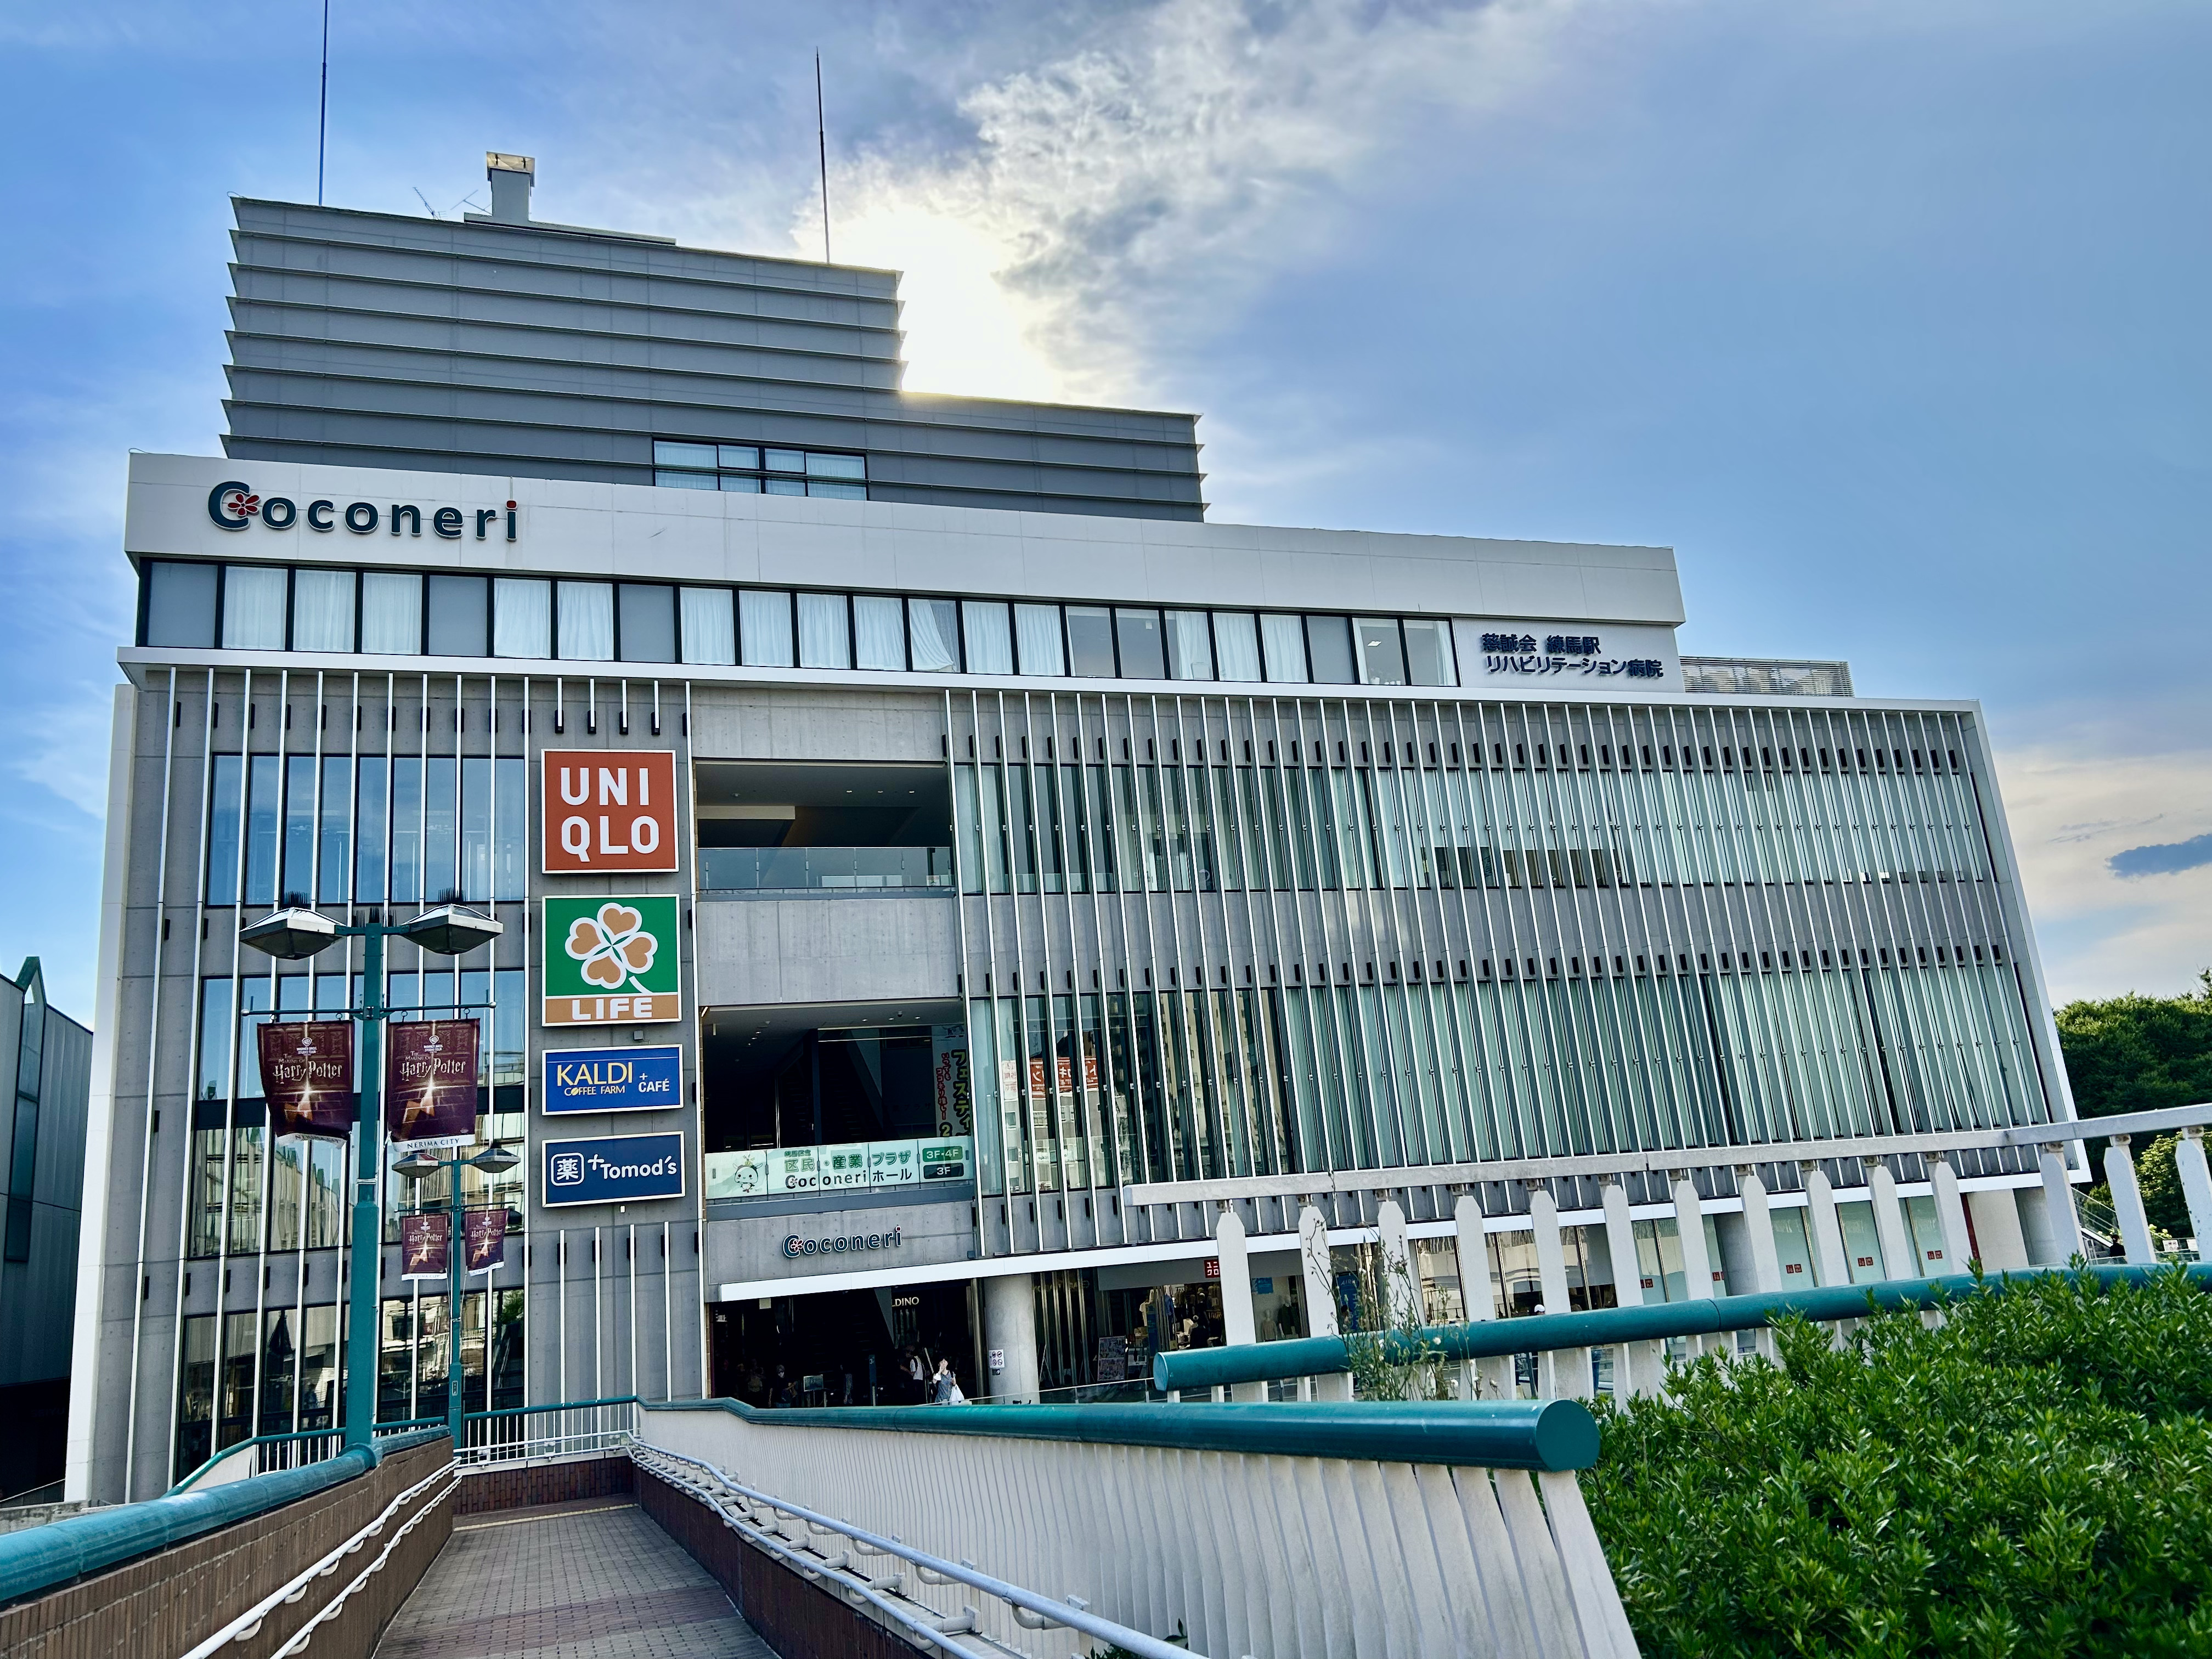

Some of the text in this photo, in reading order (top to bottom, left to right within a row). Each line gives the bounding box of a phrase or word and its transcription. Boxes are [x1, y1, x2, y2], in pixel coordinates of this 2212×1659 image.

[208, 481, 518, 541] Coconeri
[1482, 633, 1601, 654] 慈誠会 練馬駅
[1487, 655, 1664, 678] リハビリテーション病院
[561, 767, 650, 806] UNI
[561, 815, 659, 862] QLO
[572, 997, 653, 1020] LIFE
[273, 1060, 342, 1084] Harry Potter
[399, 1058, 466, 1081] Harry Potter
[557, 1062, 633, 1086] KALDI
[564, 1085, 625, 1096] COFFEE FARM
[639, 1078, 670, 1093] CAFÉ
[951, 1048, 972, 1136] フェスティ
[407, 1141, 438, 1149] NERIMA
[557, 1158, 579, 1181] 薬
[600, 1155, 677, 1180] Tomod's
[936, 1166, 951, 1175] 3F
[408, 1232, 443, 1245] Harry Potter
[470, 1227, 503, 1240] Harry Potter
[783, 1226, 902, 1258] Coconeri
